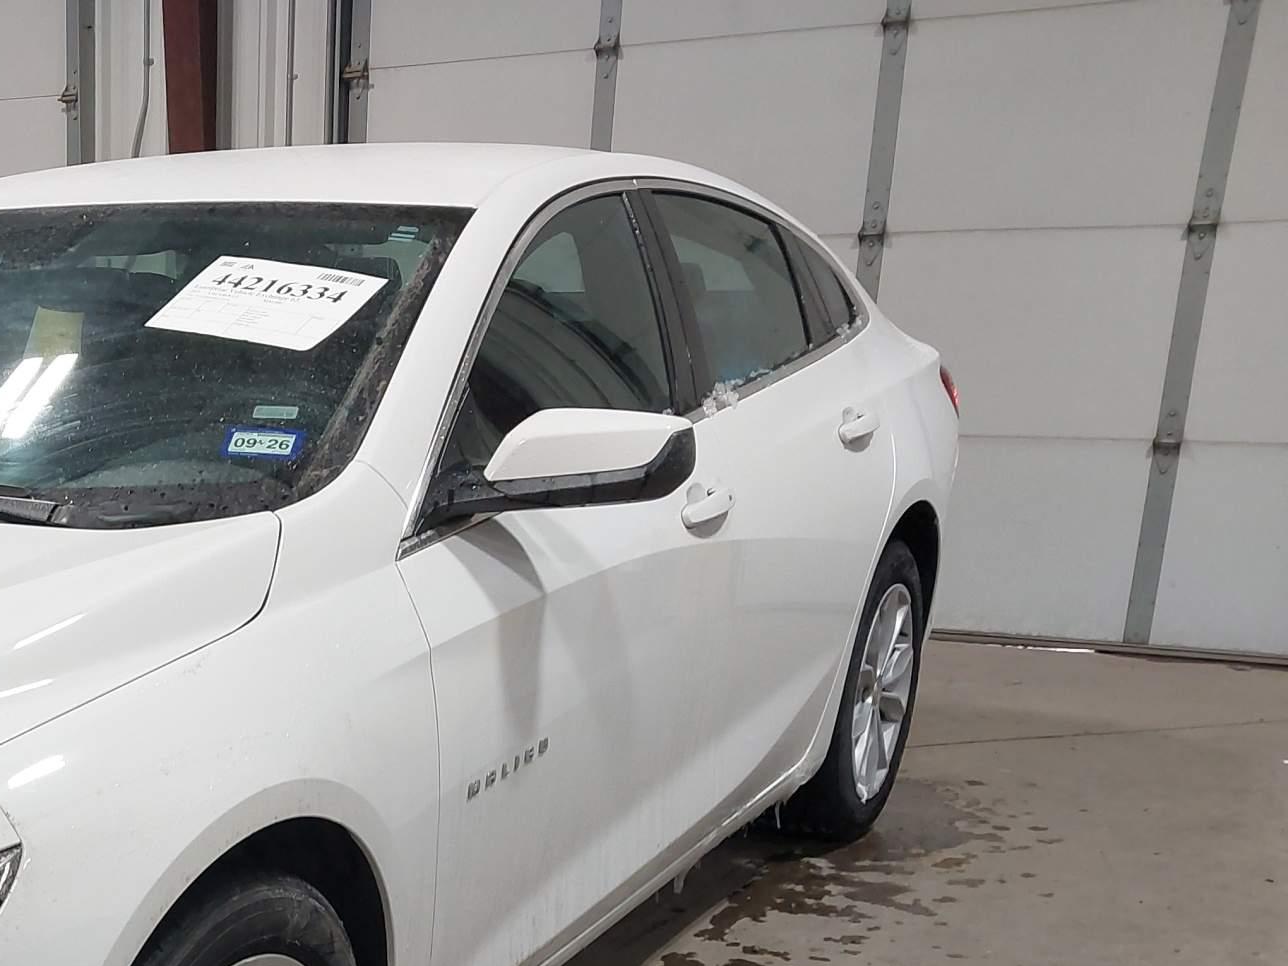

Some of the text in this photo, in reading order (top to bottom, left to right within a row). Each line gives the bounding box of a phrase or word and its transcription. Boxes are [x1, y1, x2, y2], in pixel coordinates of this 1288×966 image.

[212, 272, 349, 303] 44216334
[233, 437, 291, 450] 09 26
